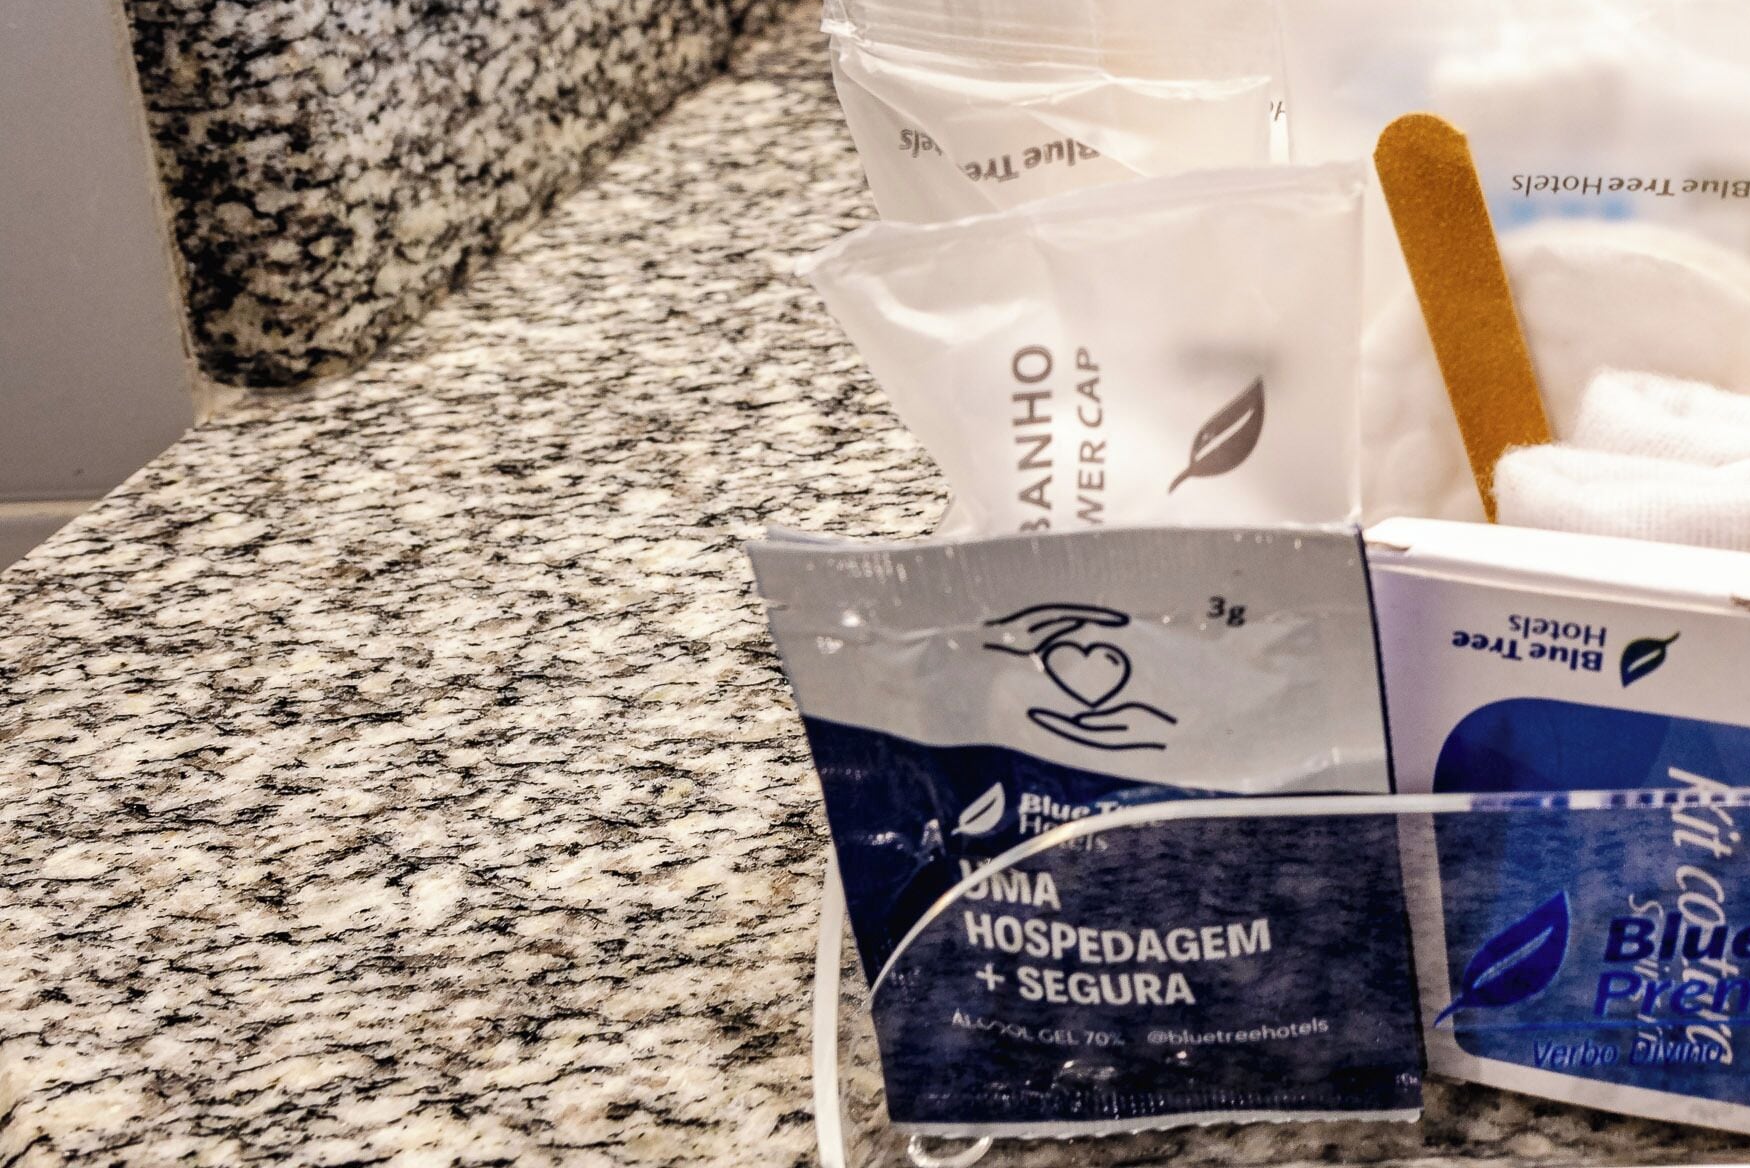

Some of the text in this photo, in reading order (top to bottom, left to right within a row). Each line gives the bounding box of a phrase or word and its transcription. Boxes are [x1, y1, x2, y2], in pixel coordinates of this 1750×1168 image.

[957, 154, 1021, 183] Tre
[1075, 347, 1103, 429] CAP
[1207, 595, 1246, 628] 3g
[1508, 613, 1607, 648] Hotels
[1451, 630, 1604, 673] Blue Tree
[1018, 792, 1092, 821] Blue
[963, 909, 1273, 965] HOSPEDAGEM
[1016, 964, 1197, 1006] SEGURA
[1038, 1028, 1080, 1046] GEL
[1147, 1017, 1329, 1045] @bluetreehotels
